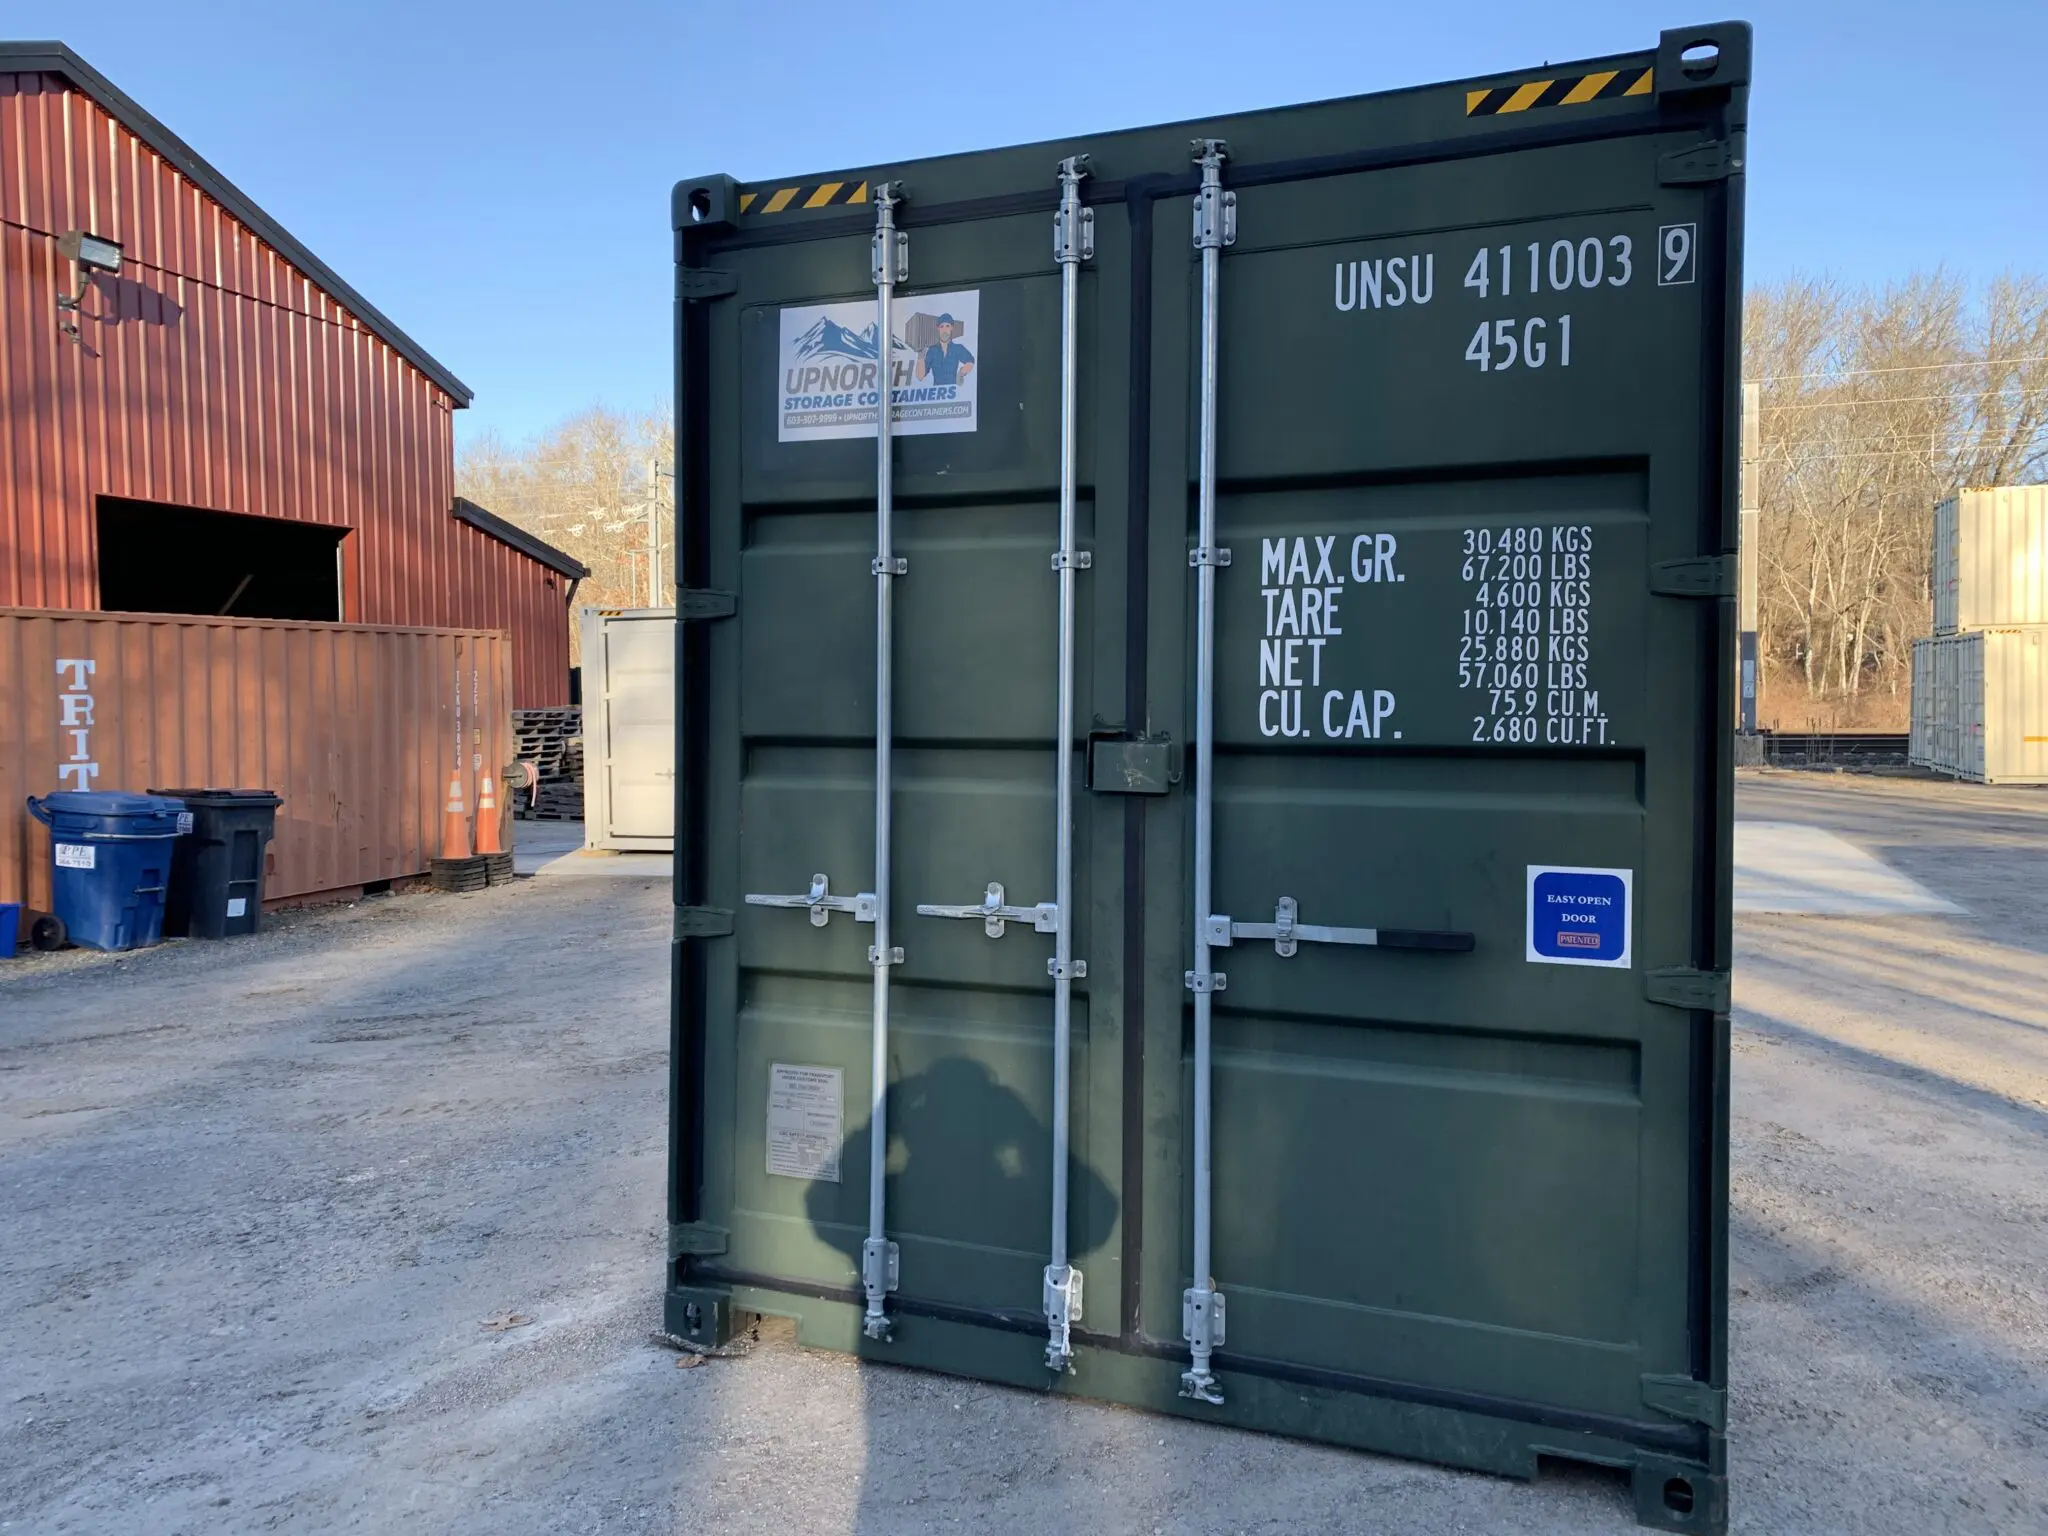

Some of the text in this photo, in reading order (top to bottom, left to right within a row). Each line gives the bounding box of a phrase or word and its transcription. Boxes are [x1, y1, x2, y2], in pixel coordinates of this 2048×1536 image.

[1335, 228, 1690, 312] UNSU 411003 9
[1465, 314, 1571, 372] 45G1
[785, 359, 915, 395] UPNORH
[784, 385, 957, 410] STORAGE COTAINERS
[1463, 528, 1543, 555] 30,480
[1551, 526, 1592, 552] KGS
[1462, 554, 1591, 582] 67,200 LBS
[1261, 581, 1591, 637] TARE 4,600 KGS
[1463, 608, 1589, 635] 10,140 LBS
[1259, 635, 1589, 687] NET 25,880 KGS
[1459, 662, 1588, 689] 57,060 LBS
[1259, 689, 1310, 738] CU.
[1322, 689, 1402, 739] CAP.
[1489, 689, 1538, 716] 75.9
[1472, 716, 1537, 743] 2,680
[1547, 894, 1612, 906] EASY OPEN
[1561, 913, 1597, 924] DOOR
[1560, 935, 1598, 945] PATENTED
